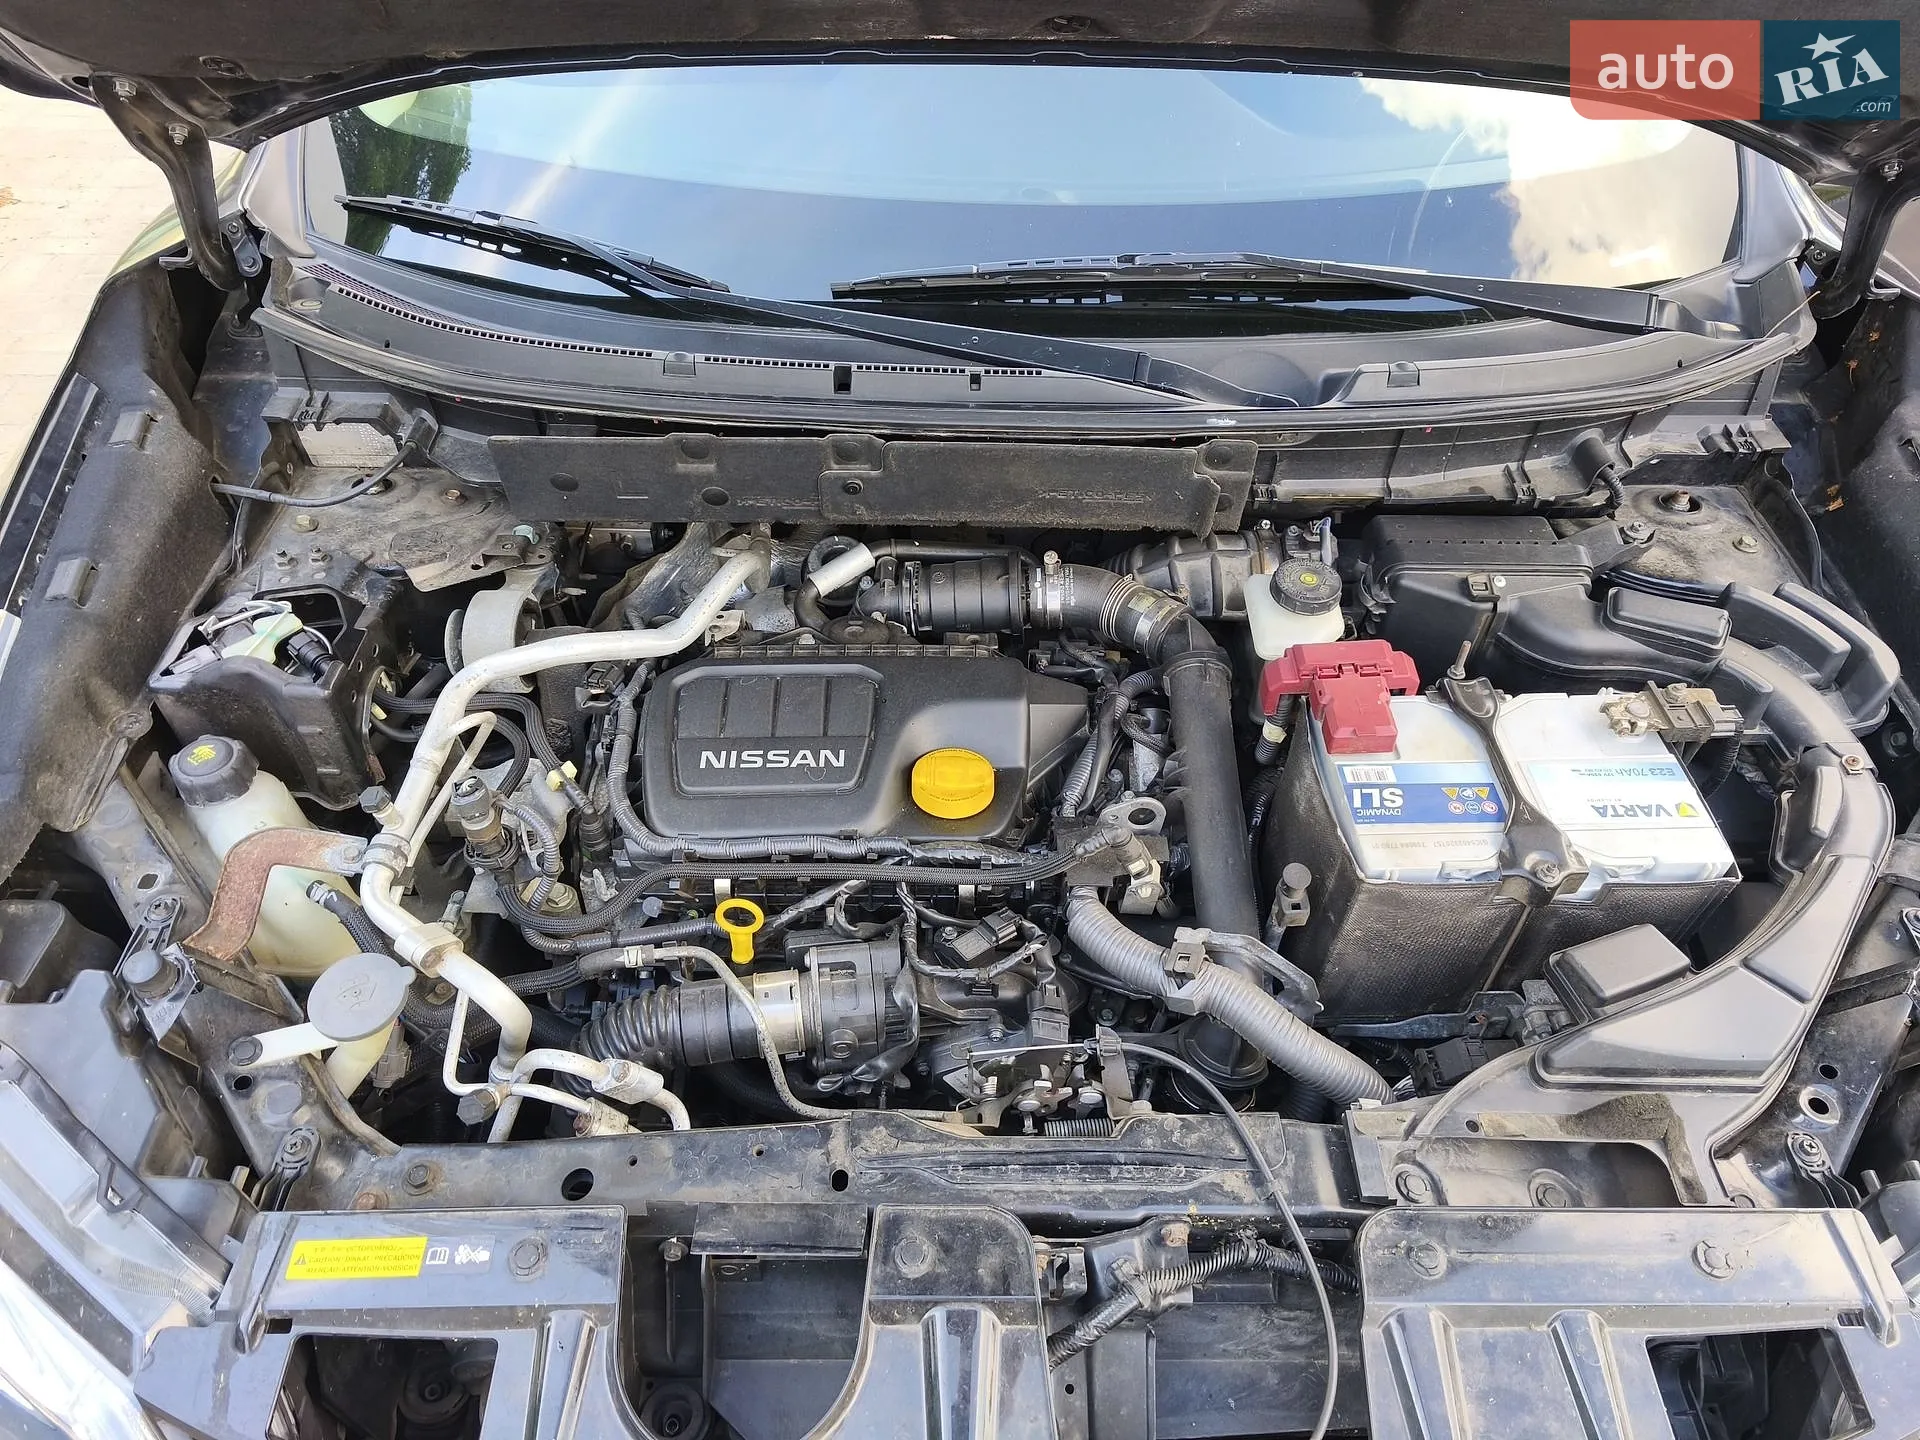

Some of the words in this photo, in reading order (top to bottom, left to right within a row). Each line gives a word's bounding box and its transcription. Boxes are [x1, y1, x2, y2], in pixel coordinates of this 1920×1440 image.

[700, 750, 845, 768] NISSAN
[1353, 787, 1404, 808] SLI
[1357, 808, 1401, 817] DYNAMIC
[1590, 803, 1673, 818] VARTA
